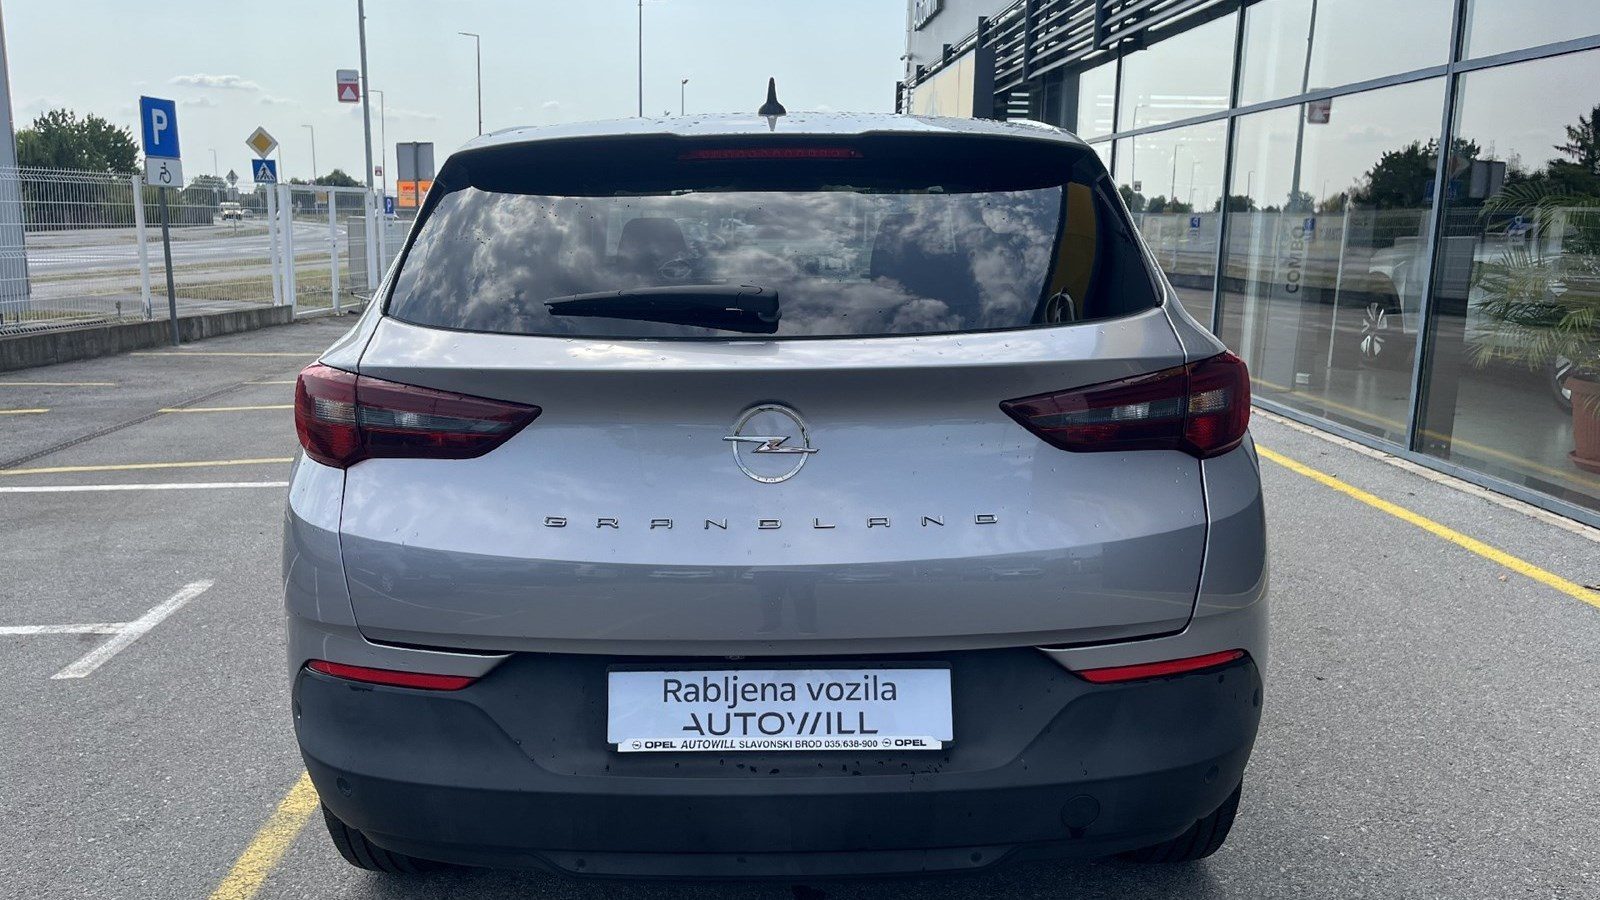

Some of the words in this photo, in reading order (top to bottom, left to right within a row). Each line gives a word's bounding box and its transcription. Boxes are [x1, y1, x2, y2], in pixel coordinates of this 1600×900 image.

[152, 108, 168, 145] P
[1286, 226, 1304, 293] COMBO
[544, 514, 998, 529] GRANDLAND
[663, 675, 796, 709] Rabljena
[806, 675, 897, 701] vozila
[683, 711, 879, 736] AUTOWILL
[644, 741, 677, 749] OPEL
[681, 740, 736, 749] AUTOWILL
[739, 740, 793, 749] SLAVONSKI
[795, 740, 822, 748] BROD
[894, 739, 927, 747] OPEL
